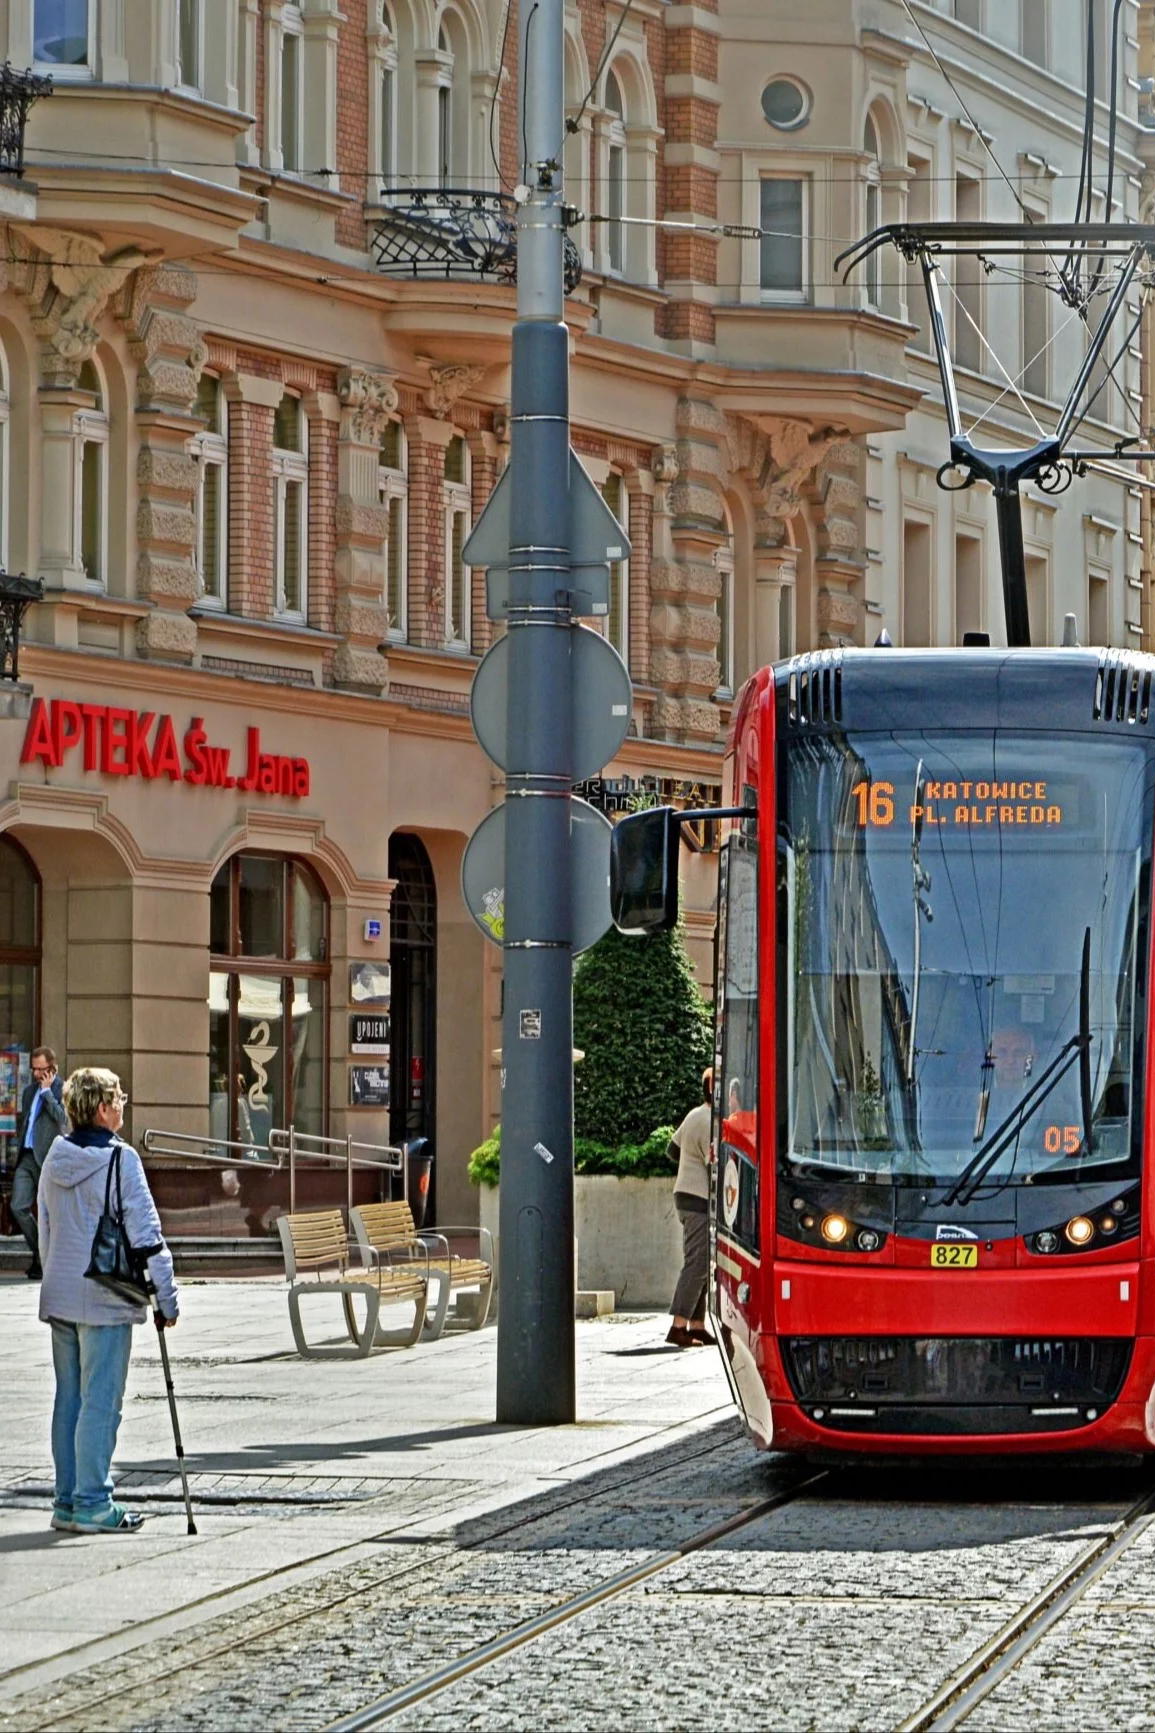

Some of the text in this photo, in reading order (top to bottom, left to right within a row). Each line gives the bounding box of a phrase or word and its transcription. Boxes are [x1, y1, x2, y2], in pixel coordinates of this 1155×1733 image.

[20, 698, 310, 796] APTEKA Św. Jana
[925, 782, 1047, 800] KATOWICE
[852, 782, 895, 825] 16
[910, 806, 1062, 823] PL. ALFREDA
[356, 1021, 387, 1040] UPOJENI
[1044, 1126, 1080, 1153] 05
[935, 1246, 974, 1265] 827
